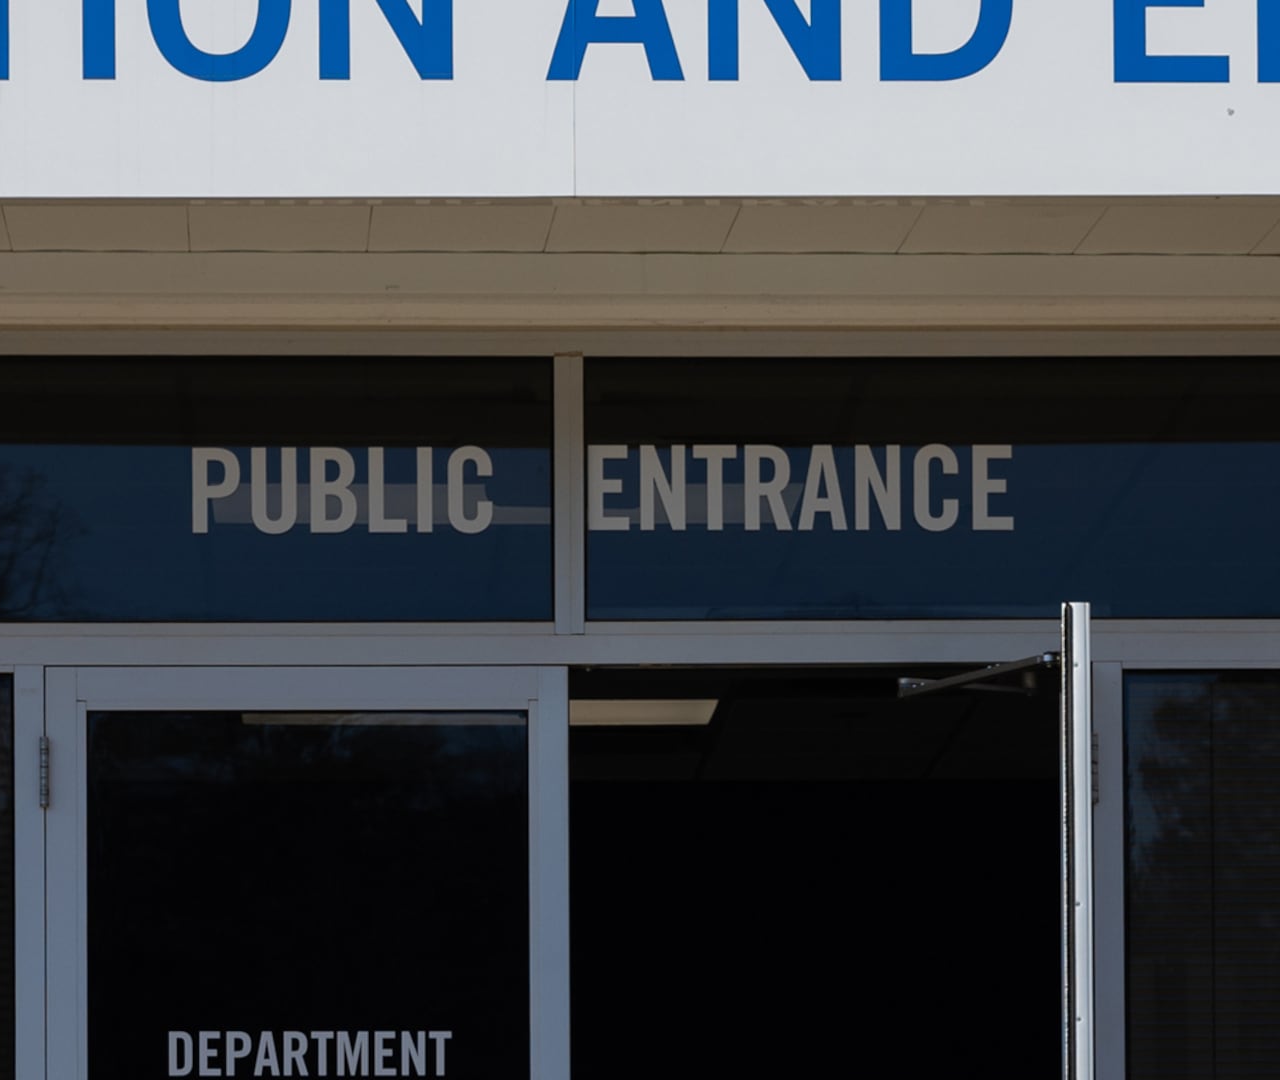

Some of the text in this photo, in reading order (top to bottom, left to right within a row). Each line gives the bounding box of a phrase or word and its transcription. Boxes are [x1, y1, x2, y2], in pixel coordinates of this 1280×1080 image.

[192, 444, 1014, 534] PUBLIC ENTRANCE
[168, 1030, 453, 1077] DEPARTMENT
